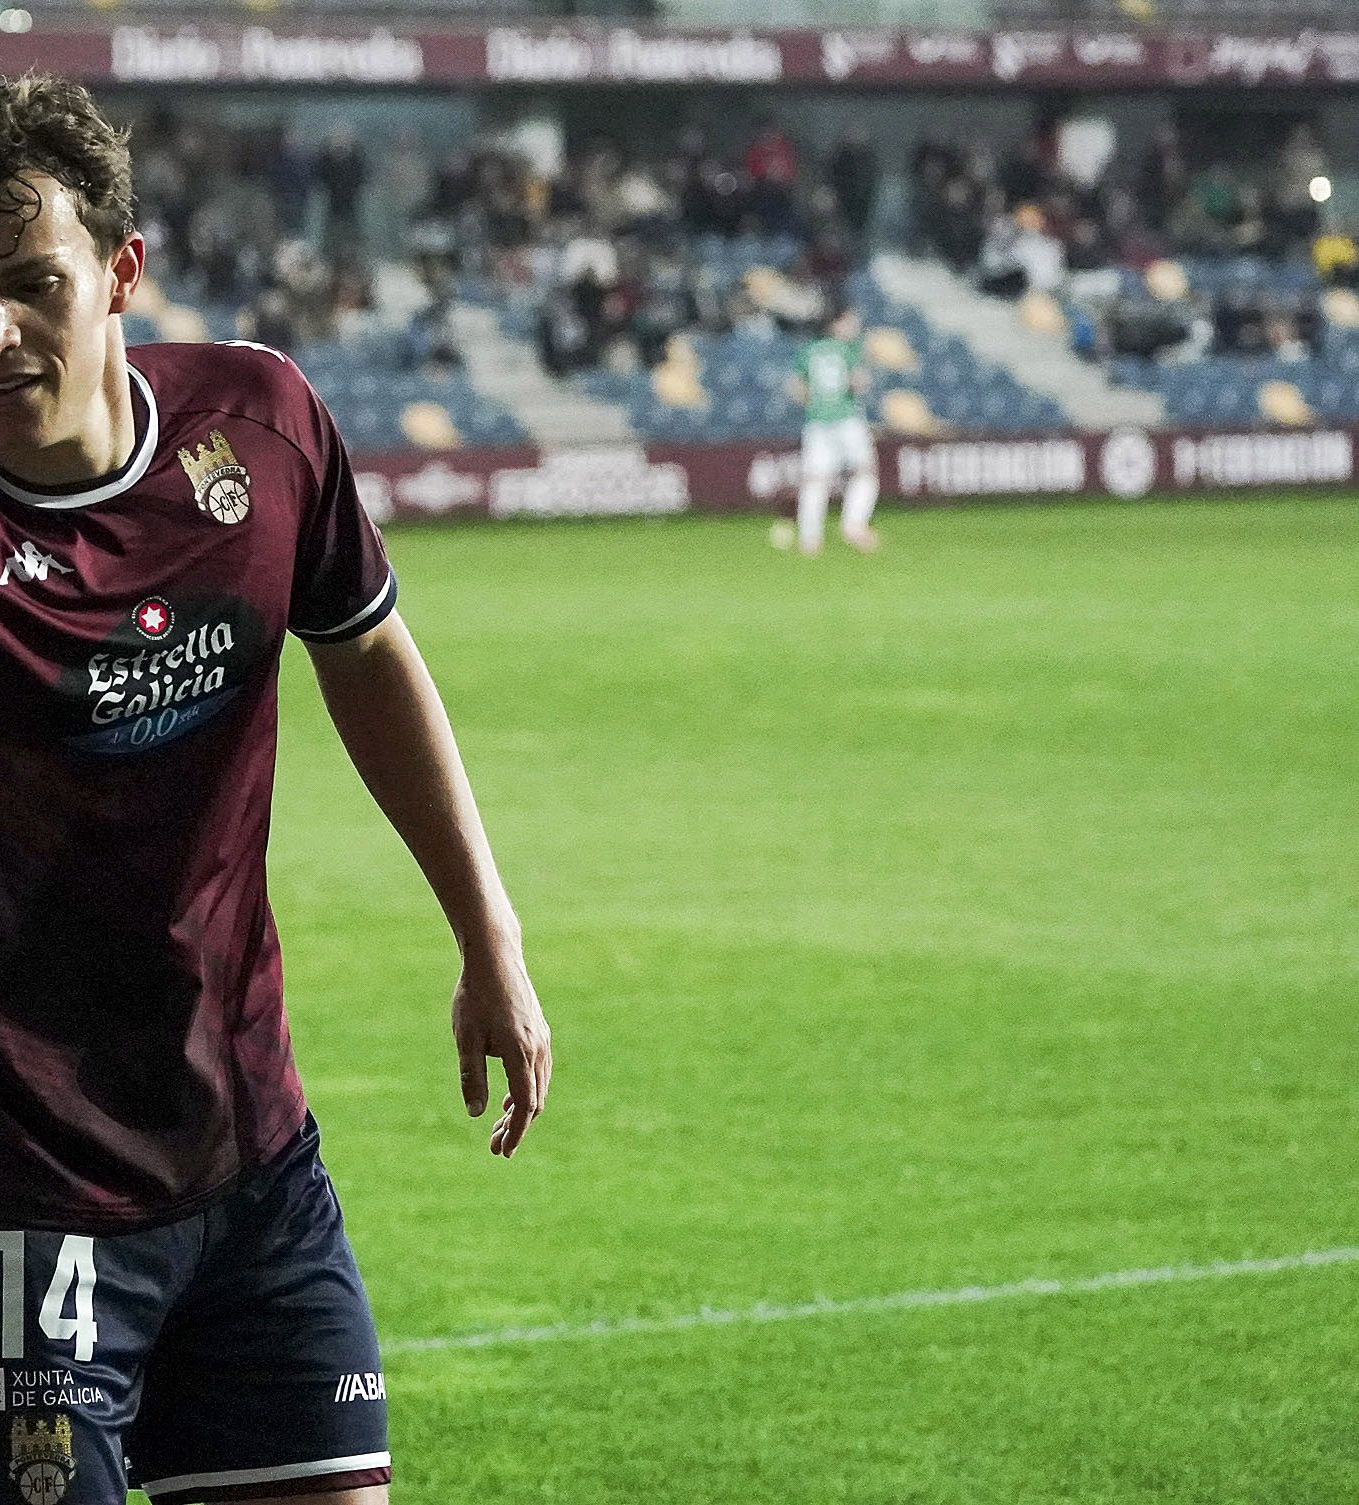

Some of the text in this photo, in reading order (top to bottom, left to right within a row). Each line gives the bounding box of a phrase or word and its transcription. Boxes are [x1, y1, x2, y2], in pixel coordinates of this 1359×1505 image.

[88, 622, 235, 695] Estrella
[92, 664, 225, 725] Galicia
[130, 707, 178, 745] 0,0
[12, 1370, 74, 1387] XUNTA
[12, 1387, 104, 1407] DE GALICIA
